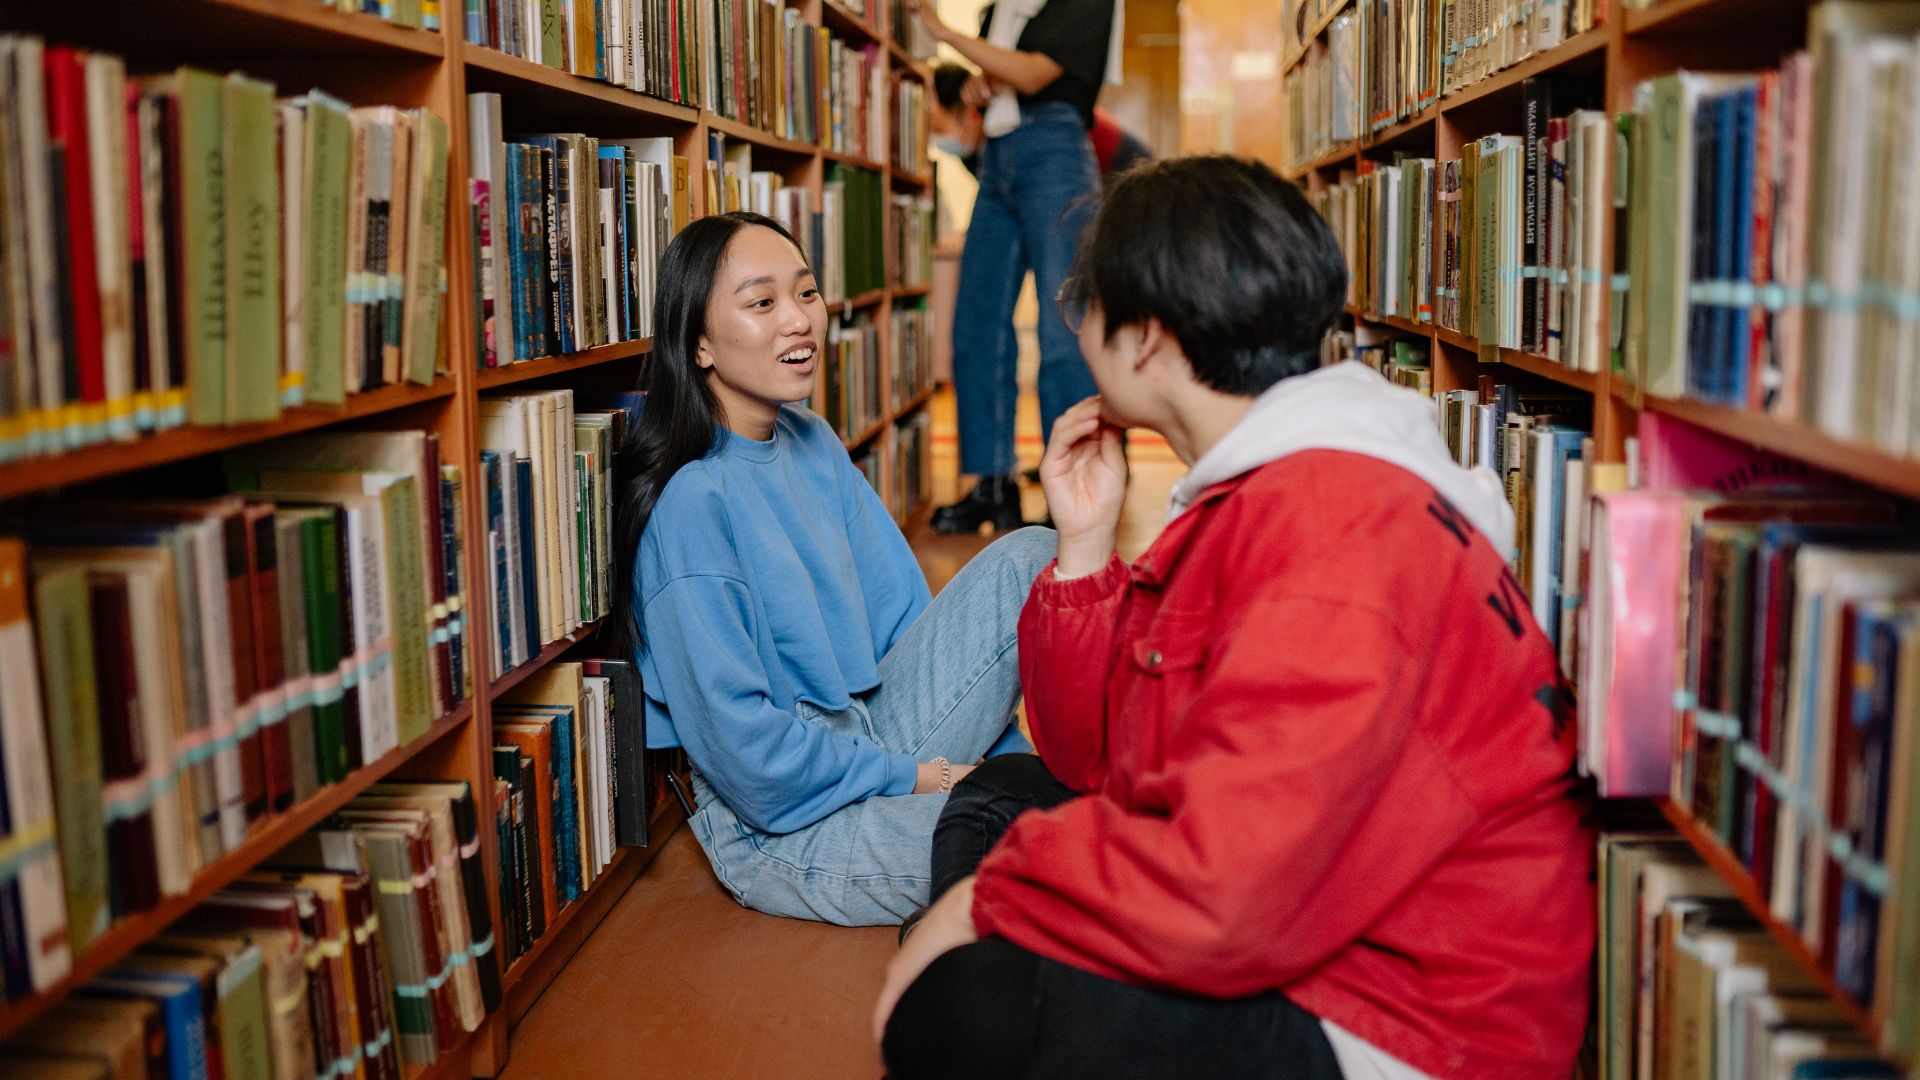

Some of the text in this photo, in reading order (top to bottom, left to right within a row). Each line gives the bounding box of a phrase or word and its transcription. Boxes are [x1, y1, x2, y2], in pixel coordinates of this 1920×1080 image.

[676, 167, 685, 192] Б
[1526, 100, 1537, 244] КИТАЙСКАЯ ЛИТЕРАТУРА
[547, 194, 559, 283] АСТАФЬЕВ
